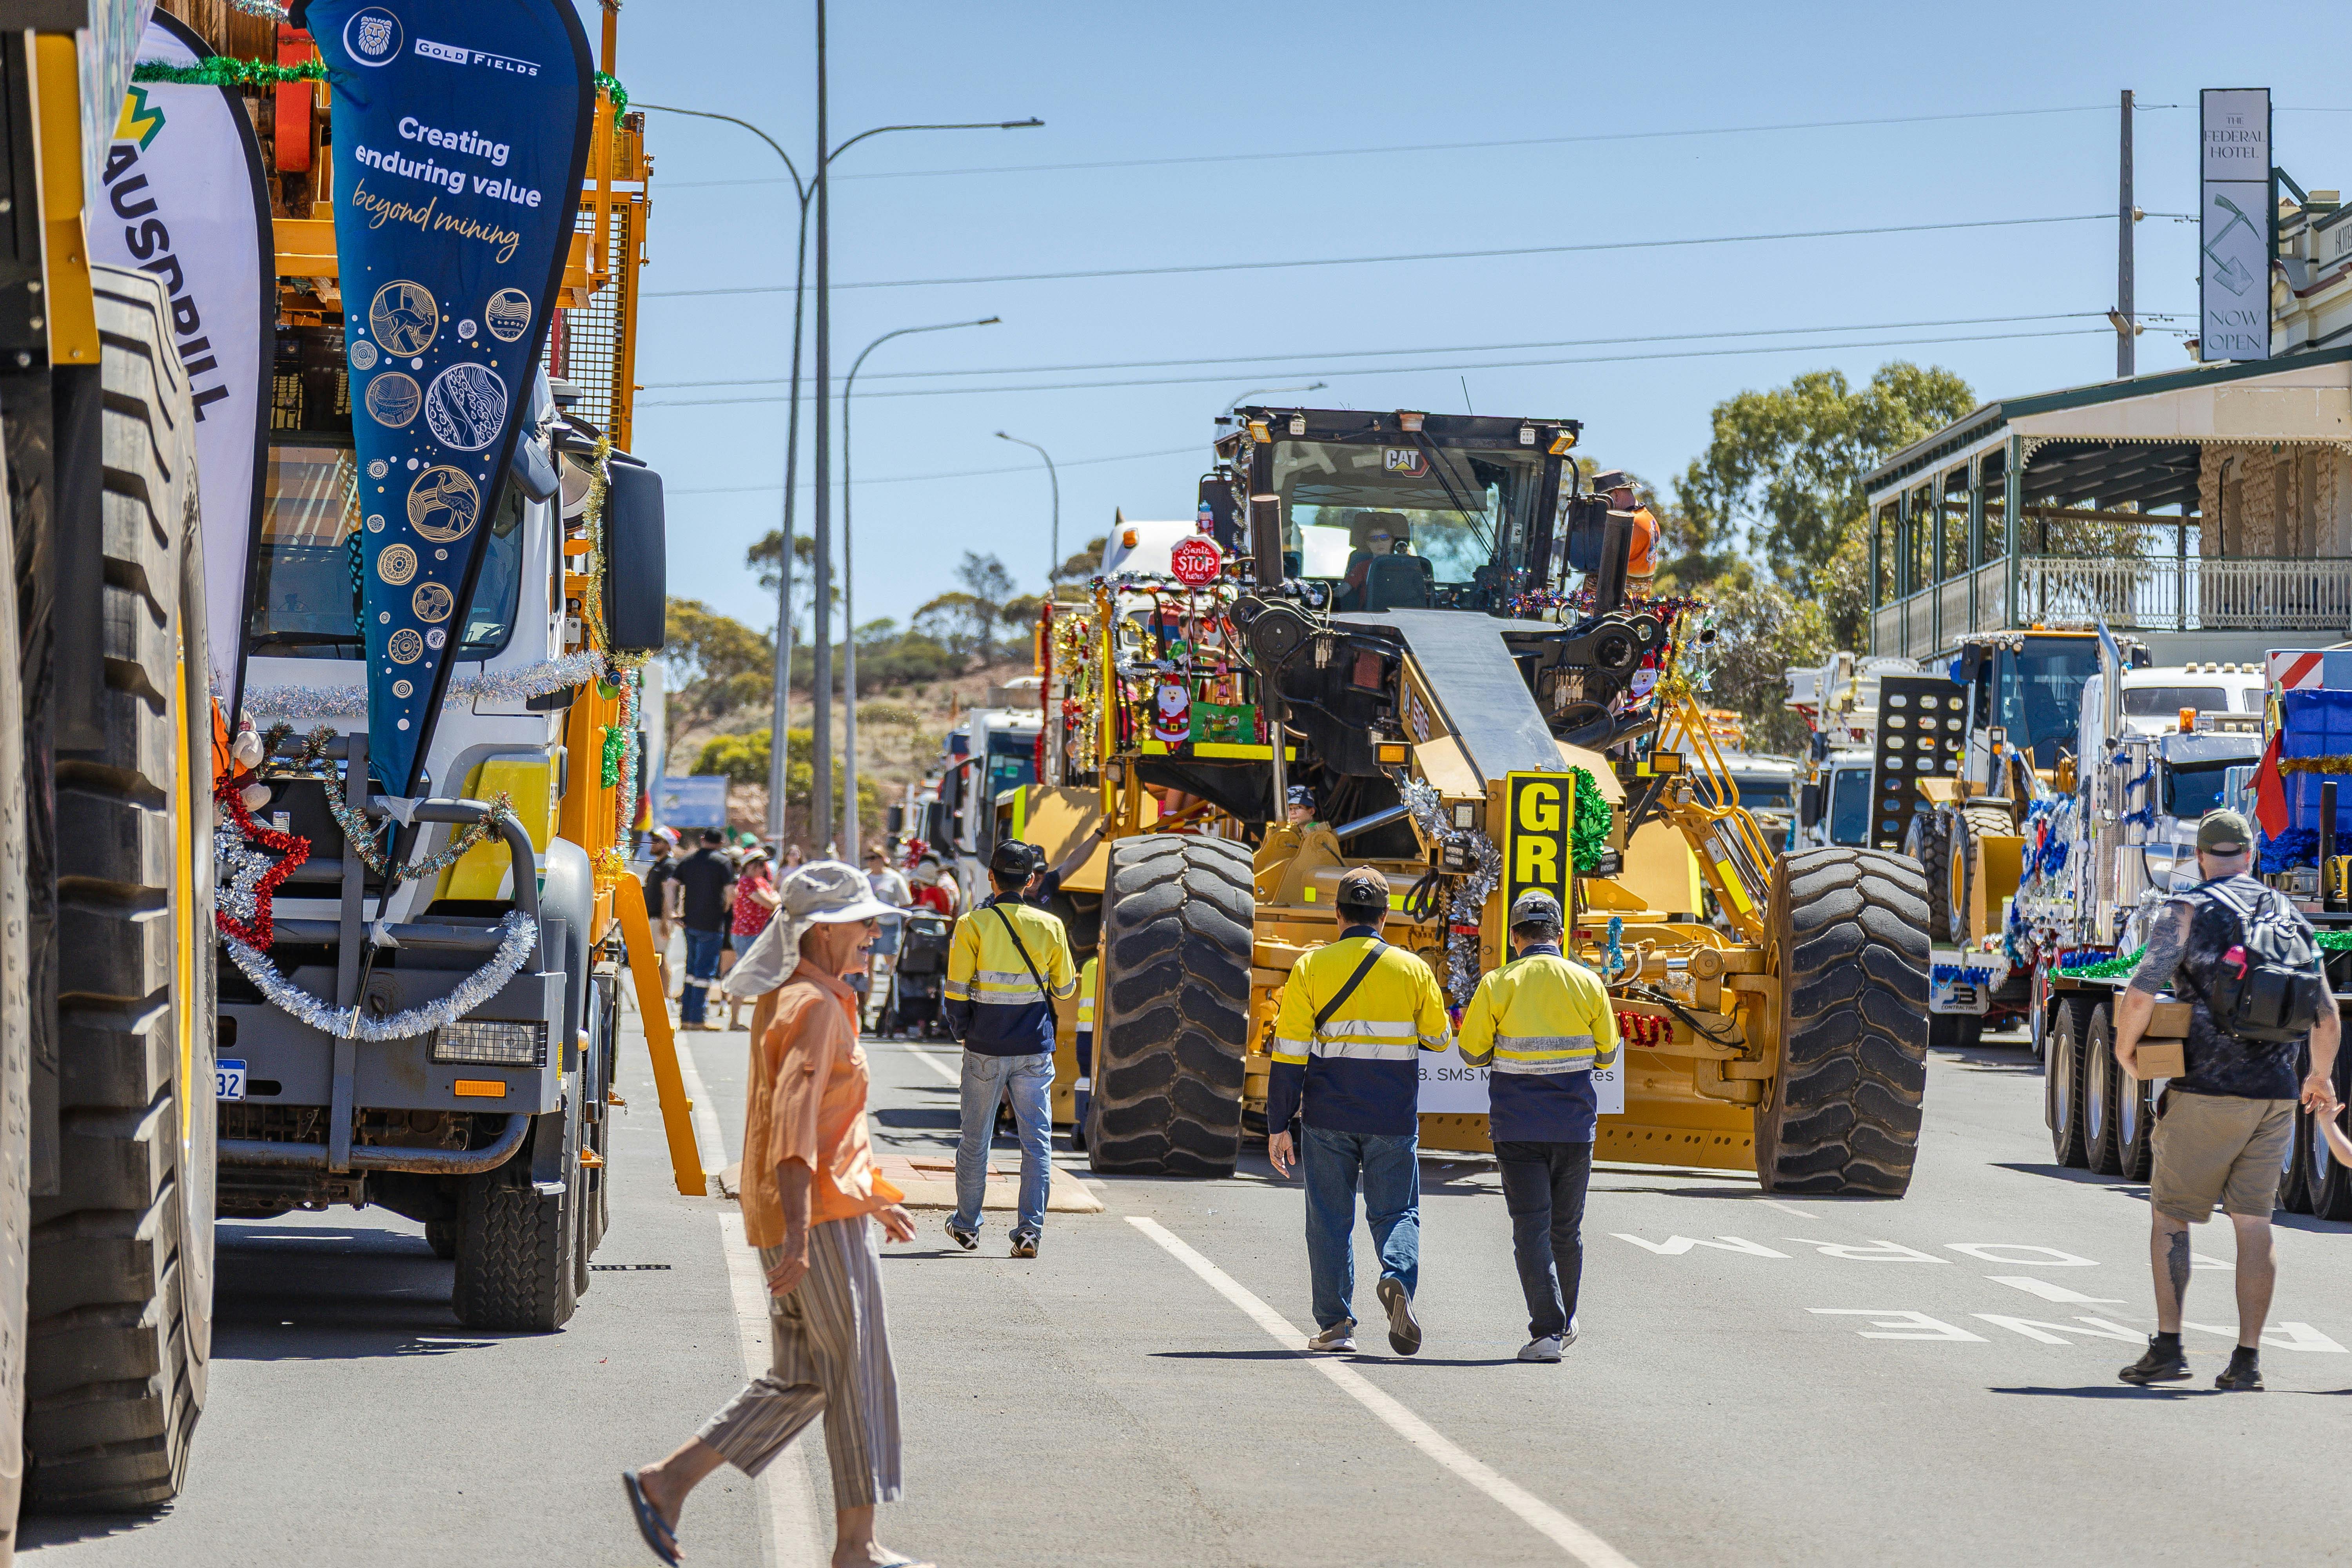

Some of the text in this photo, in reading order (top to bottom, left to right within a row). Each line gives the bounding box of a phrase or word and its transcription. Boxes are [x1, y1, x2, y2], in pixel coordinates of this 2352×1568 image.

[419, 43, 538, 76] GOLD FIELDS
[2226, 116, 2244, 125] THE
[399, 117, 510, 167] Creating
[2204, 130, 2265, 143] FEDERAL
[2210, 146, 2259, 159] HOTEL
[356, 145, 541, 207] enduring value
[352, 178, 520, 263] beyond mining
[2210, 310, 2261, 327] NOW
[2209, 334, 2261, 351] OPEN
[1385, 450, 1419, 470] CAT
[1183, 544, 1212, 555] Santa
[1178, 555, 1215, 572] STOP
[1185, 571, 1205, 580] here
[1516, 783, 1560, 898] GR
[1437, 1068, 1475, 1081] SMS
